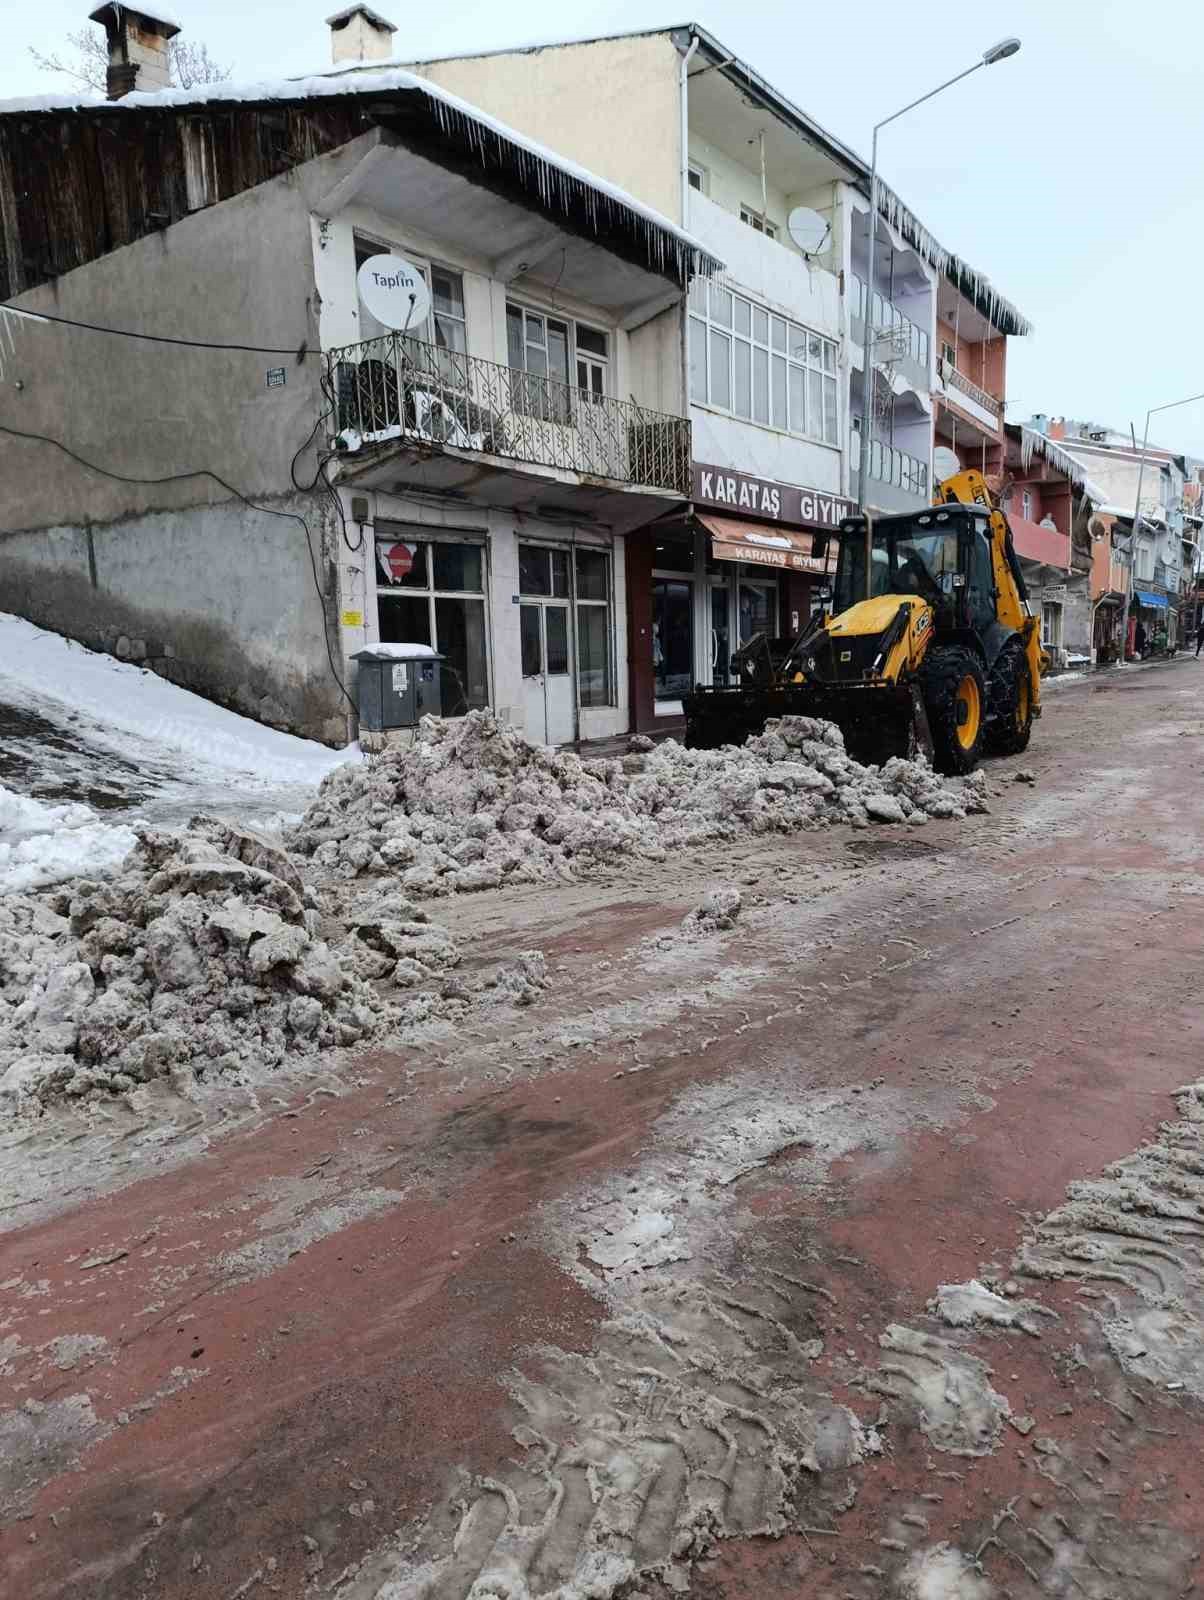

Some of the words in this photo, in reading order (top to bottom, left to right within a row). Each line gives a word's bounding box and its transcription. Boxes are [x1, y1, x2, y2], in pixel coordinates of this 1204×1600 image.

[371, 270, 414, 289] Taplin
[701, 471, 780, 519] KARATAŞ
[800, 493, 847, 526] GİYİM
